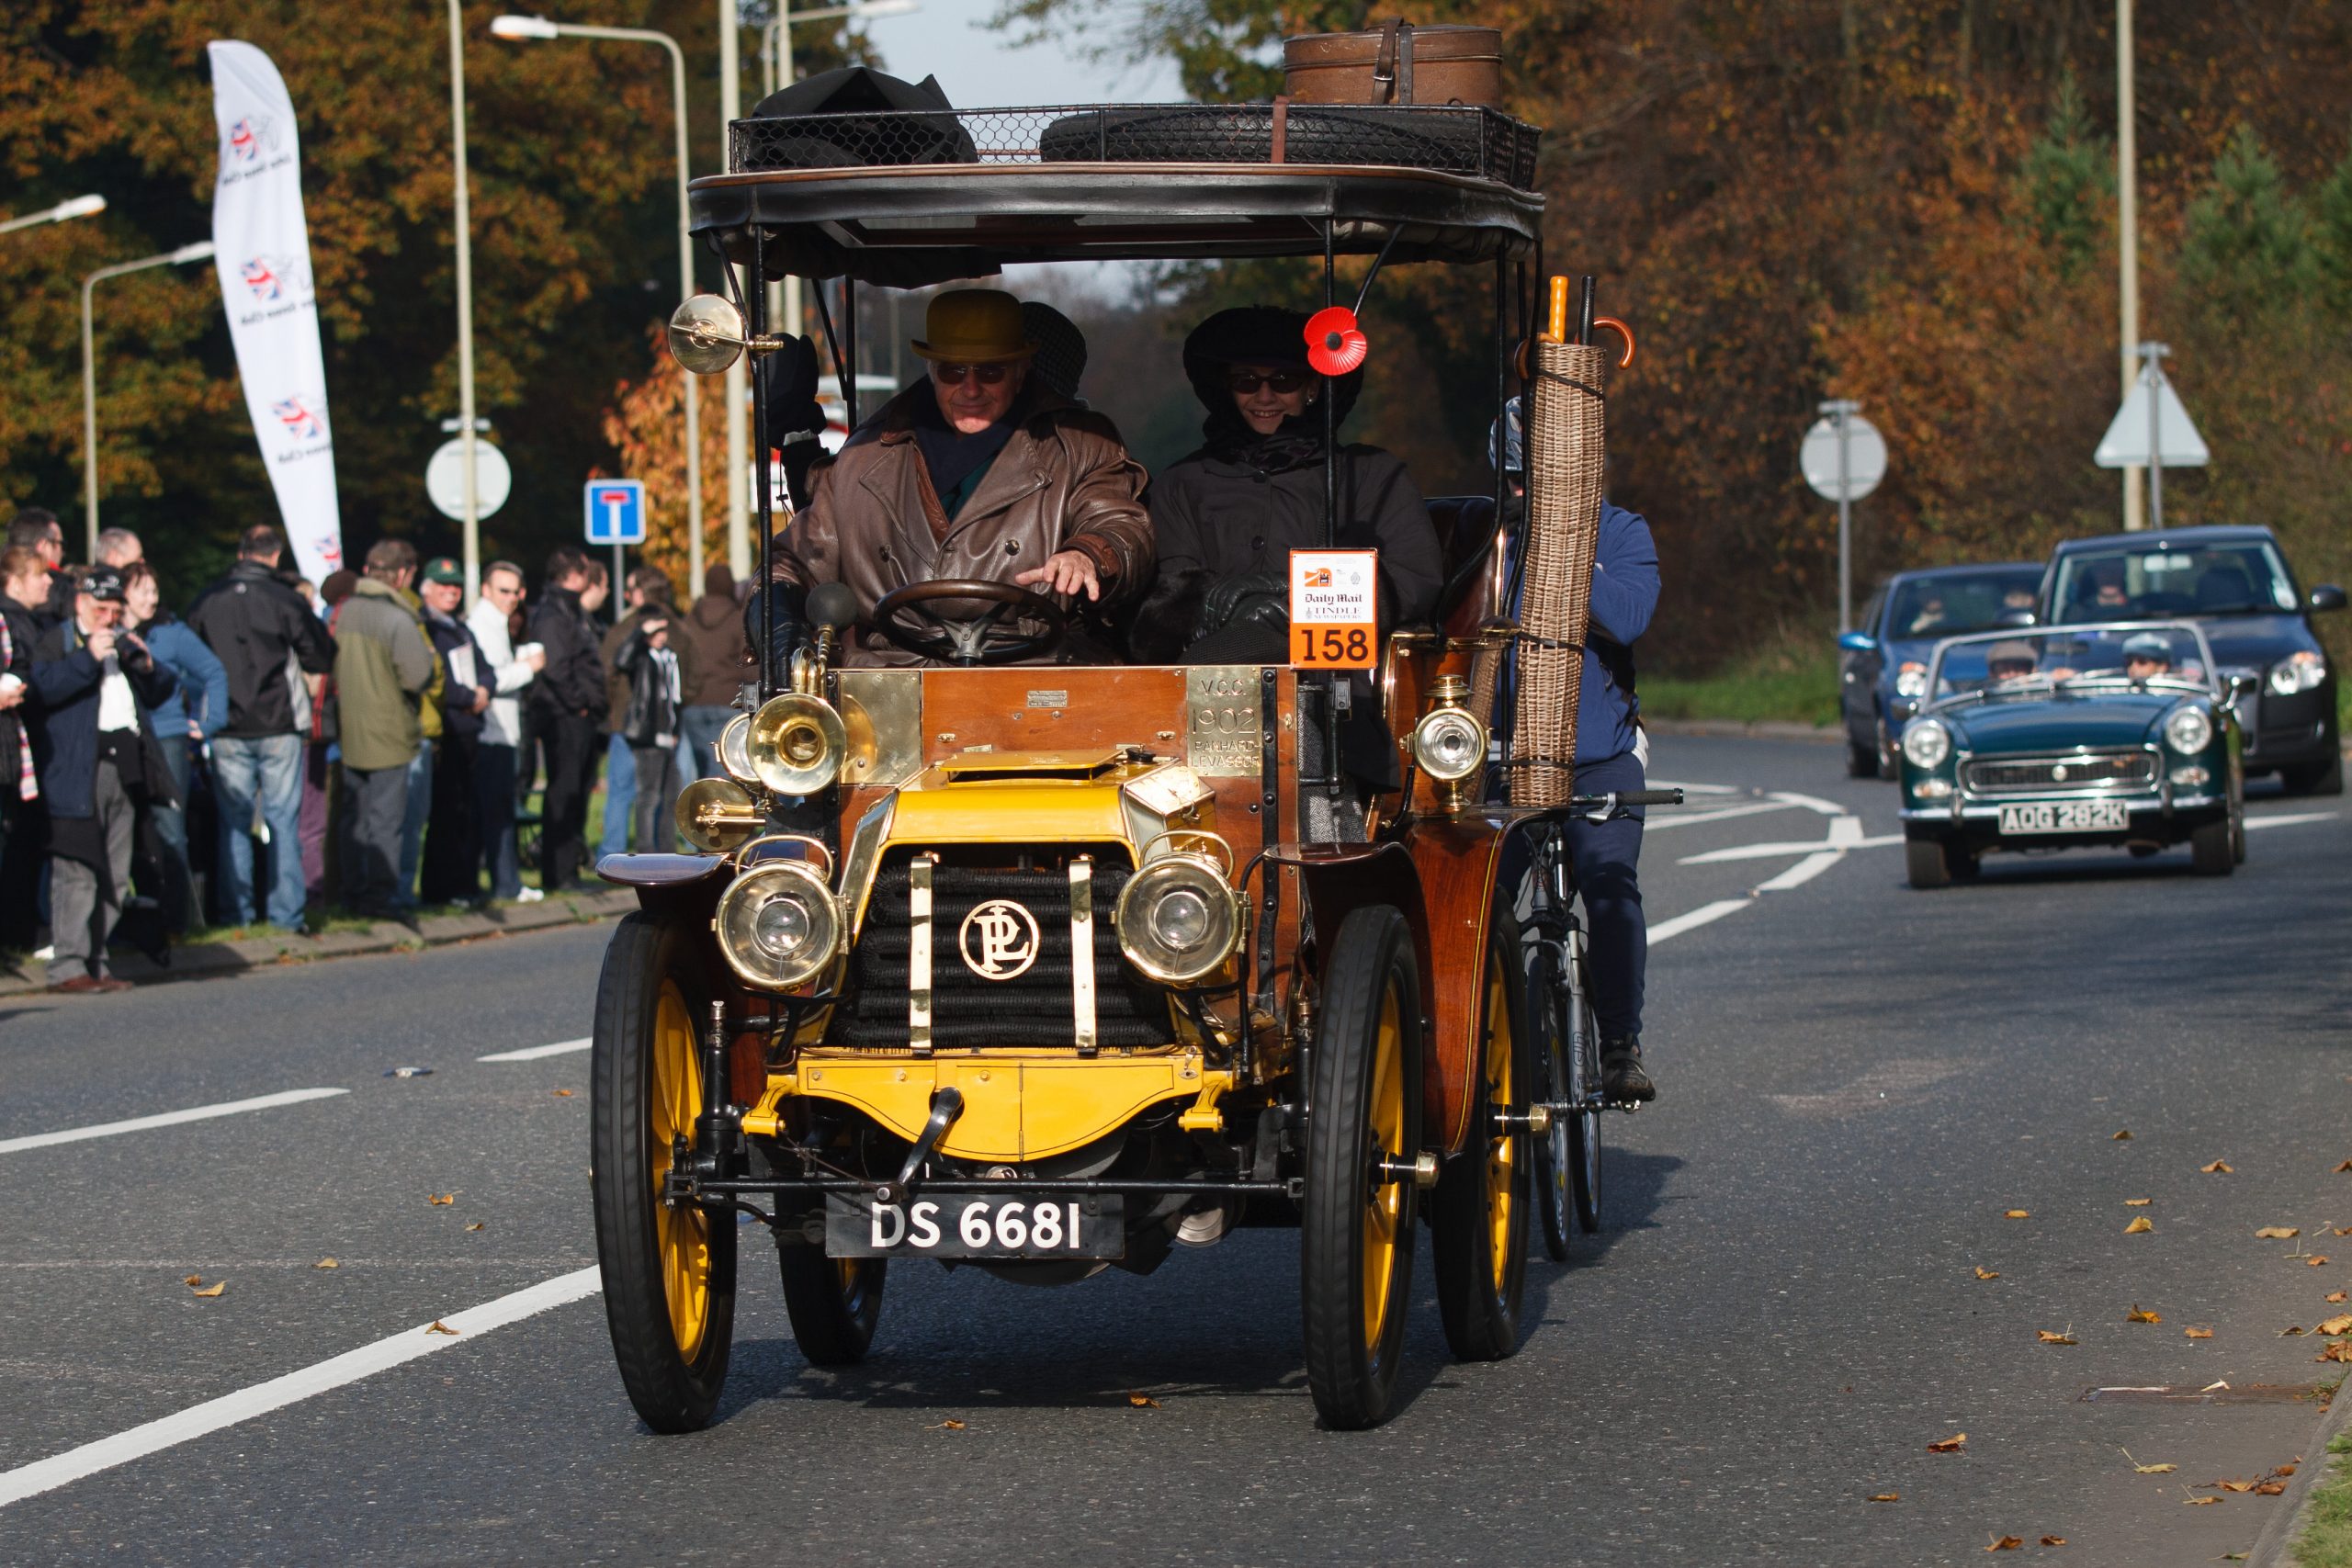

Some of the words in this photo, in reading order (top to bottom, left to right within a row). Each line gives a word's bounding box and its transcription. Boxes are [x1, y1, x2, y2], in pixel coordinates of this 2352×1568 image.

[1305, 593, 1335, 605] Daily
[1336, 593, 1363, 603] Mail
[1301, 628, 1369, 661] 158
[1201, 679, 1248, 697] V.C.C.
[1192, 707, 1257, 735] 1902
[2002, 807, 2054, 831] AOG
[871, 1201, 942, 1249] DS
[959, 1201, 1080, 1249] 6681
